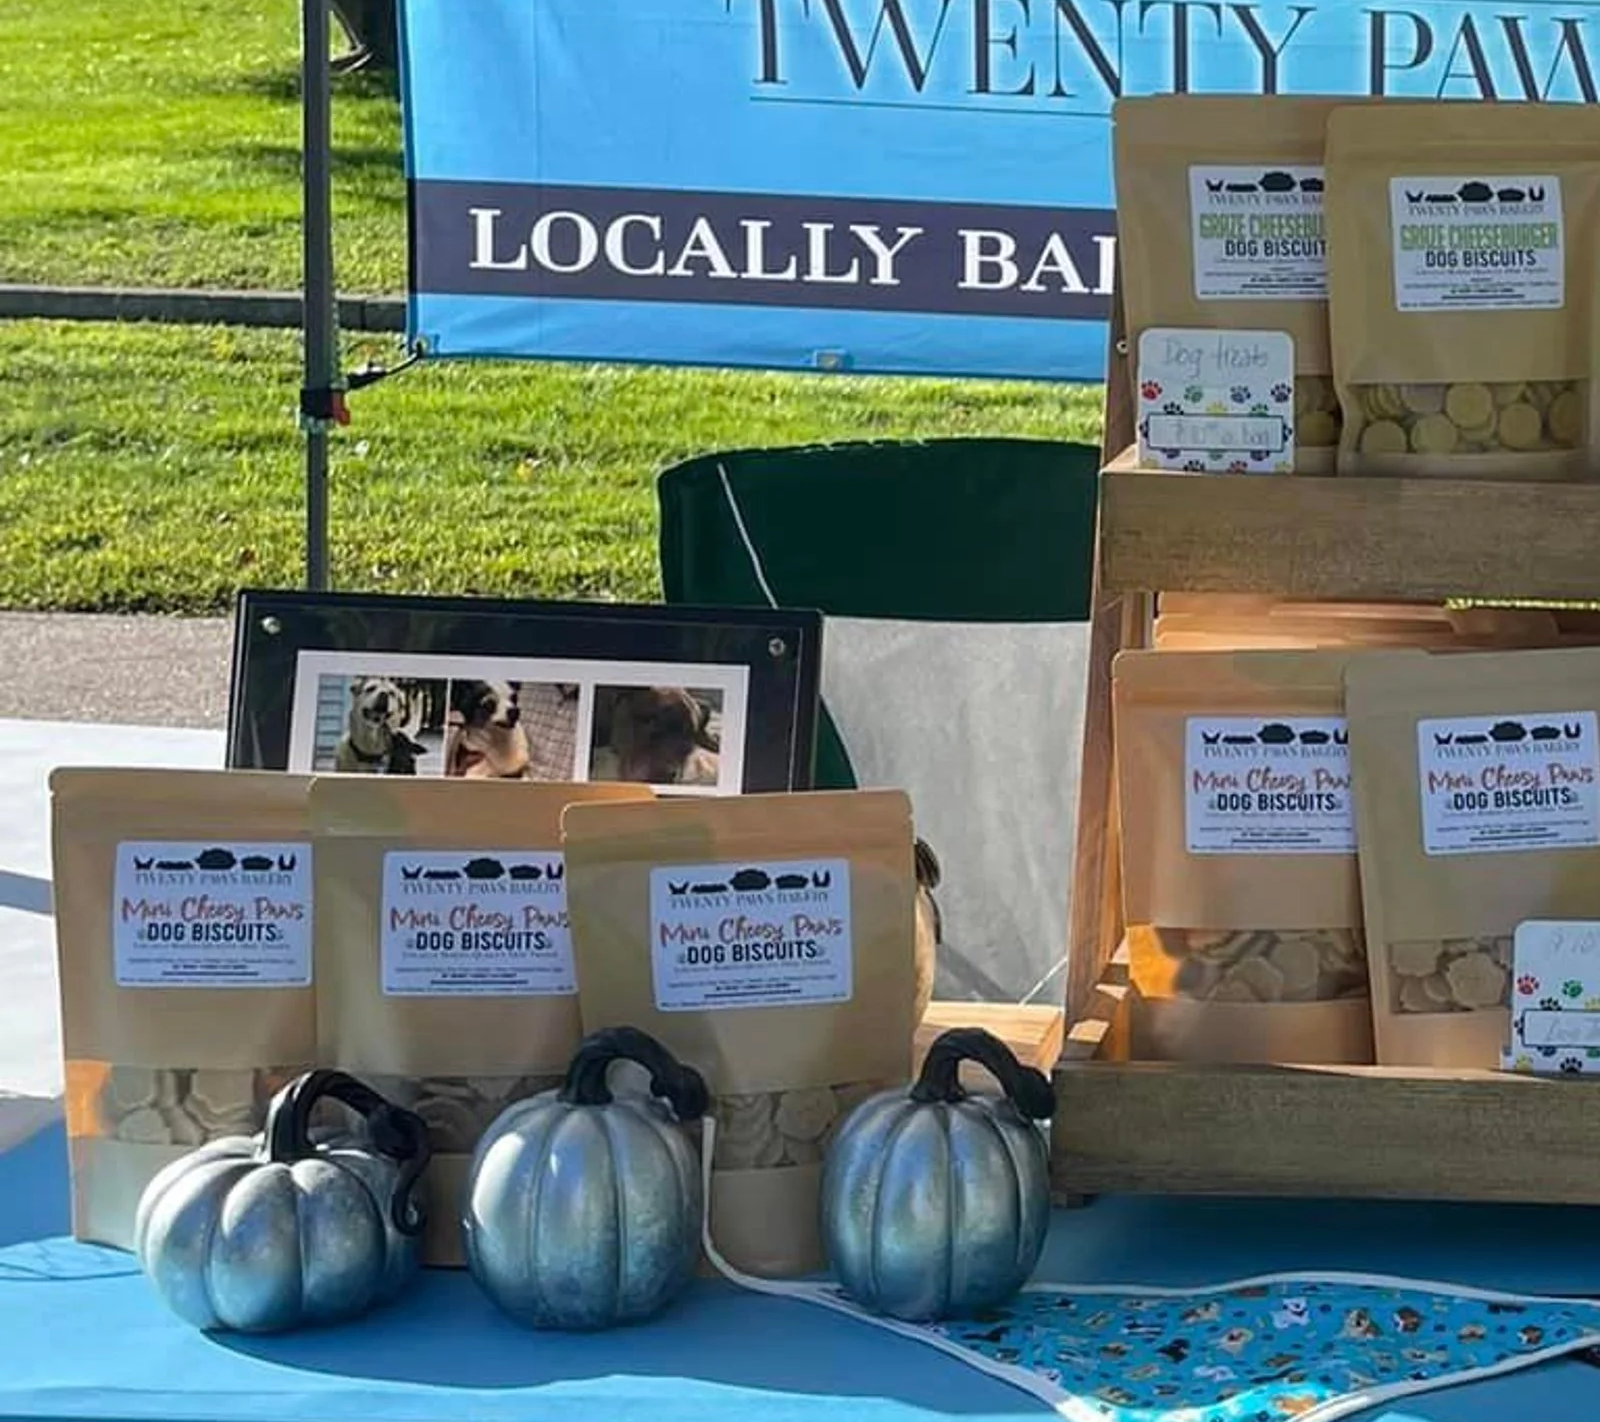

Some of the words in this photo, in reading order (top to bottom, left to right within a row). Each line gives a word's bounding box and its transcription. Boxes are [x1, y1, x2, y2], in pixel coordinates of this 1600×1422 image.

[468, 207, 923, 285] LOCALLY
[1225, 240, 1258, 257] DOG
[1264, 240, 1326, 257] BISCUIT
[1426, 251, 1457, 267] DOG
[1463, 249, 1537, 267] BISCUITS
[1161, 338, 1203, 377] Dog
[1193, 769, 1239, 793] Mini
[1247, 766, 1305, 793] Cheesy
[1313, 768, 1351, 789] Paw
[1428, 770, 1474, 794] Mini
[1482, 764, 1540, 791] Cheesy
[1548, 762, 1593, 784] Paws
[1217, 794, 1251, 811] DOG
[1258, 794, 1336, 811] BISCUITS
[1454, 792, 1488, 810] DOG
[1494, 788, 1571, 808] BISCUITS
[122, 897, 172, 922] Mini
[181, 894, 244, 922] Cheesy
[255, 896, 303, 921] Paws
[391, 907, 440, 931] Mini
[449, 904, 513, 932] Cheesy
[523, 905, 569, 928] Paws
[147, 923, 184, 941] DOG
[191, 923, 277, 941] BISCUITS
[416, 932, 454, 950] DOG
[461, 931, 546, 950] BISCUITS
[660, 922, 709, 947] Mini
[718, 915, 784, 944] Cheesy
[793, 914, 843, 937] Paws
[687, 945, 725, 964] DOG
[732, 940, 818, 962] BISCUITS
